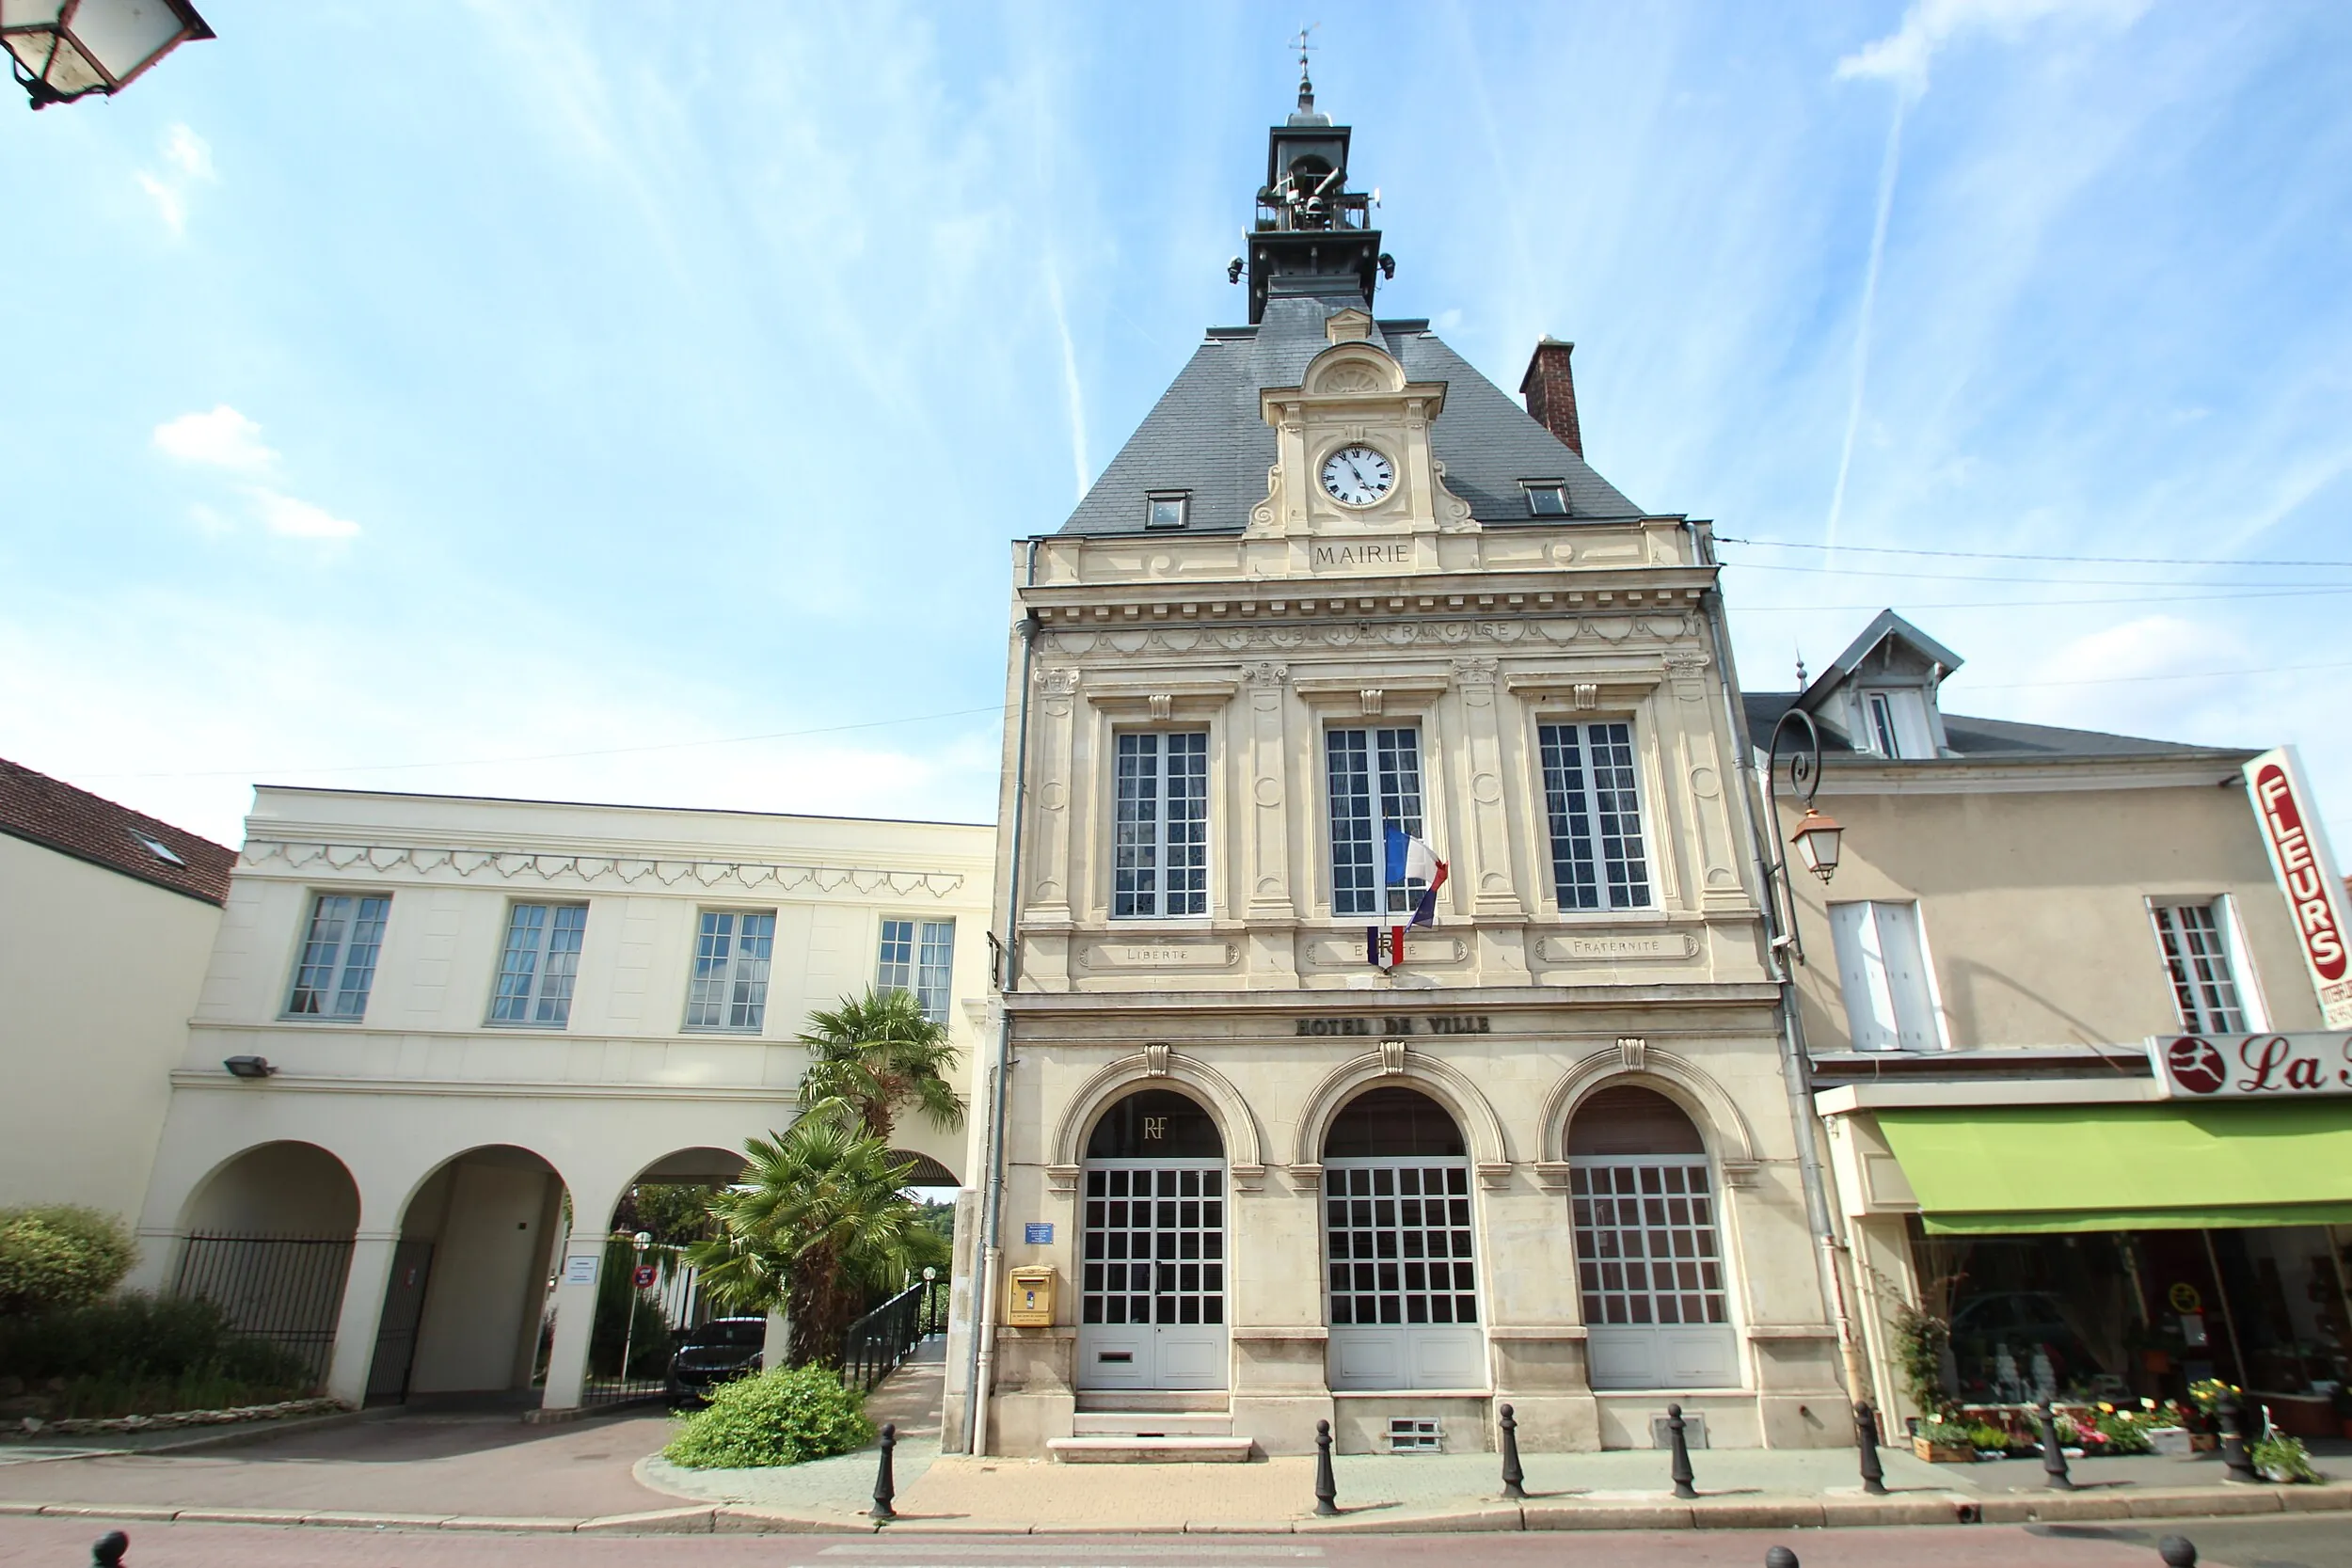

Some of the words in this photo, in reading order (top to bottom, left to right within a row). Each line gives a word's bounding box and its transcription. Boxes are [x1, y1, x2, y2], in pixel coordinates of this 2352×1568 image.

[1315, 544, 1409, 565] MAIRIE
[2259, 775, 2343, 965] FLEURS
[1295, 1019, 1369, 1036] HOTEL
[1384, 1017, 1413, 1035] DE
[1427, 1016, 1490, 1034] VILLE
[2237, 1036, 2328, 1092] La
[1144, 1117, 1167, 1139] RF
